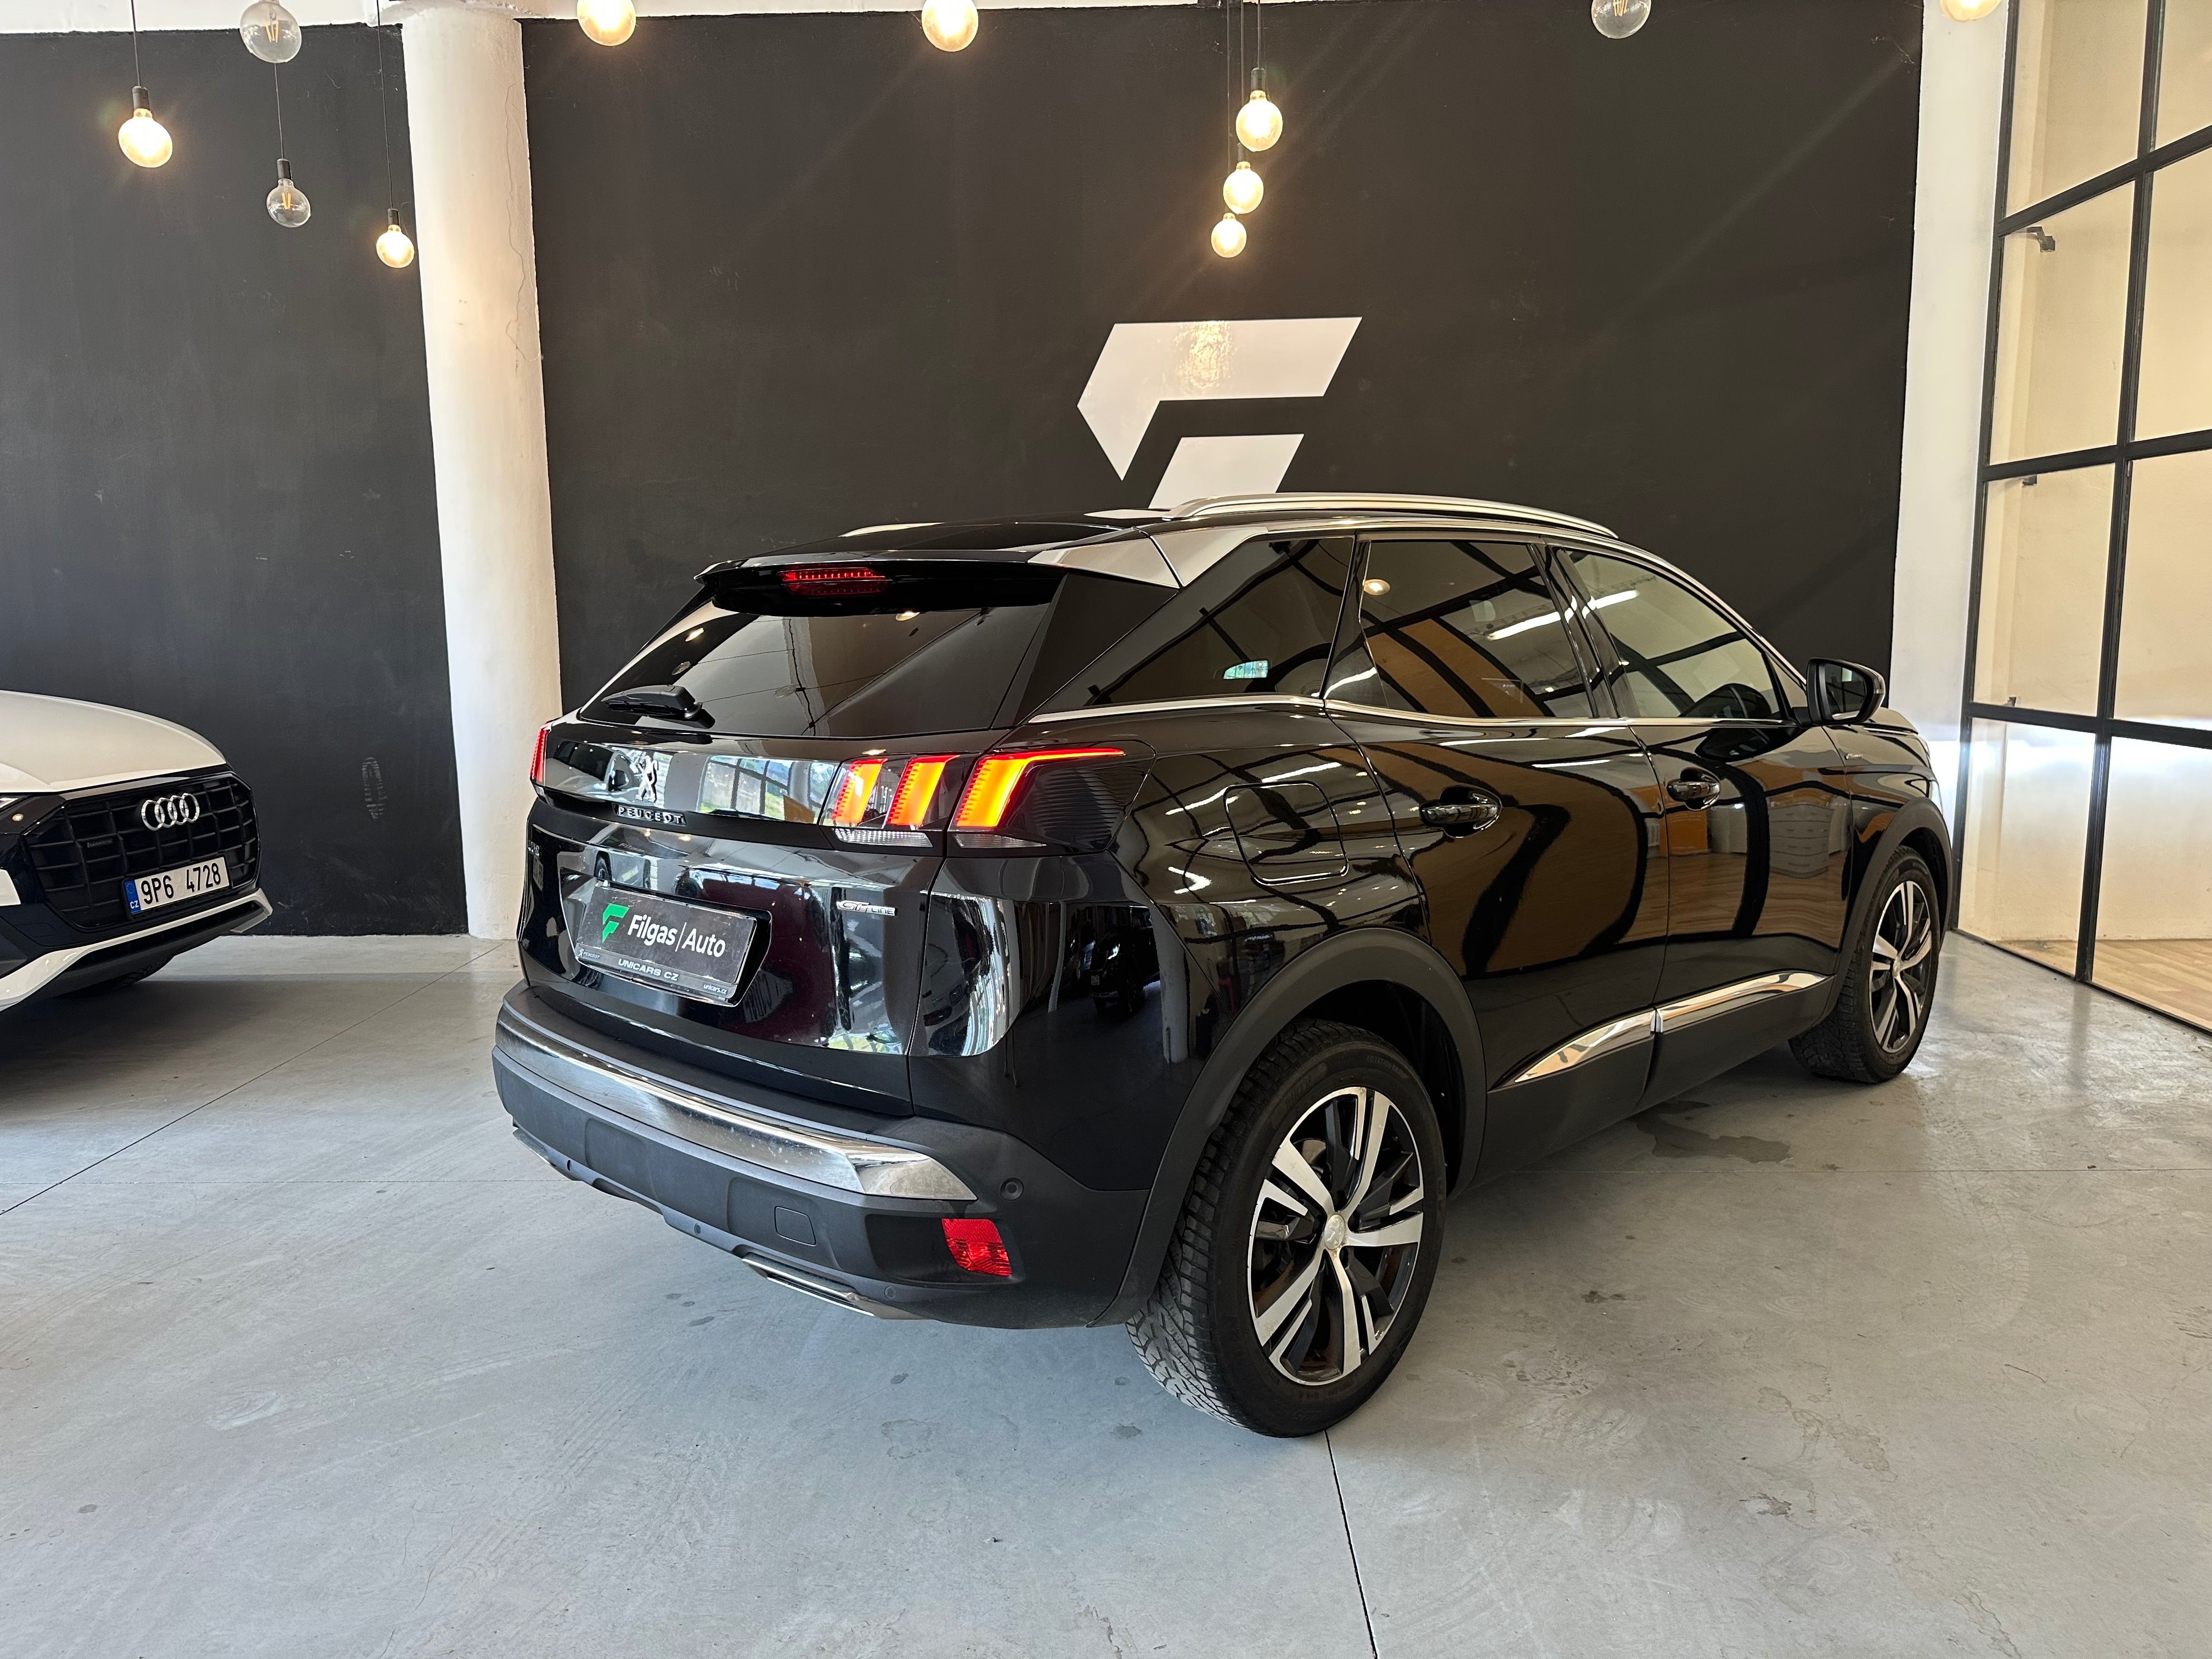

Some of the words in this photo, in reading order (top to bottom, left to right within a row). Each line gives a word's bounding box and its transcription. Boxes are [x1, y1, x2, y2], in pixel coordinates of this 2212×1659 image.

[618, 806, 683, 825] PEUGEOT
[140, 874, 174, 905] 9P6
[186, 862, 221, 893] 4728
[129, 900, 140, 909] CZ
[618, 958, 662, 977] UNICARS
[664, 971, 679, 981] CZ
[703, 983, 727, 995] unicars.cz
